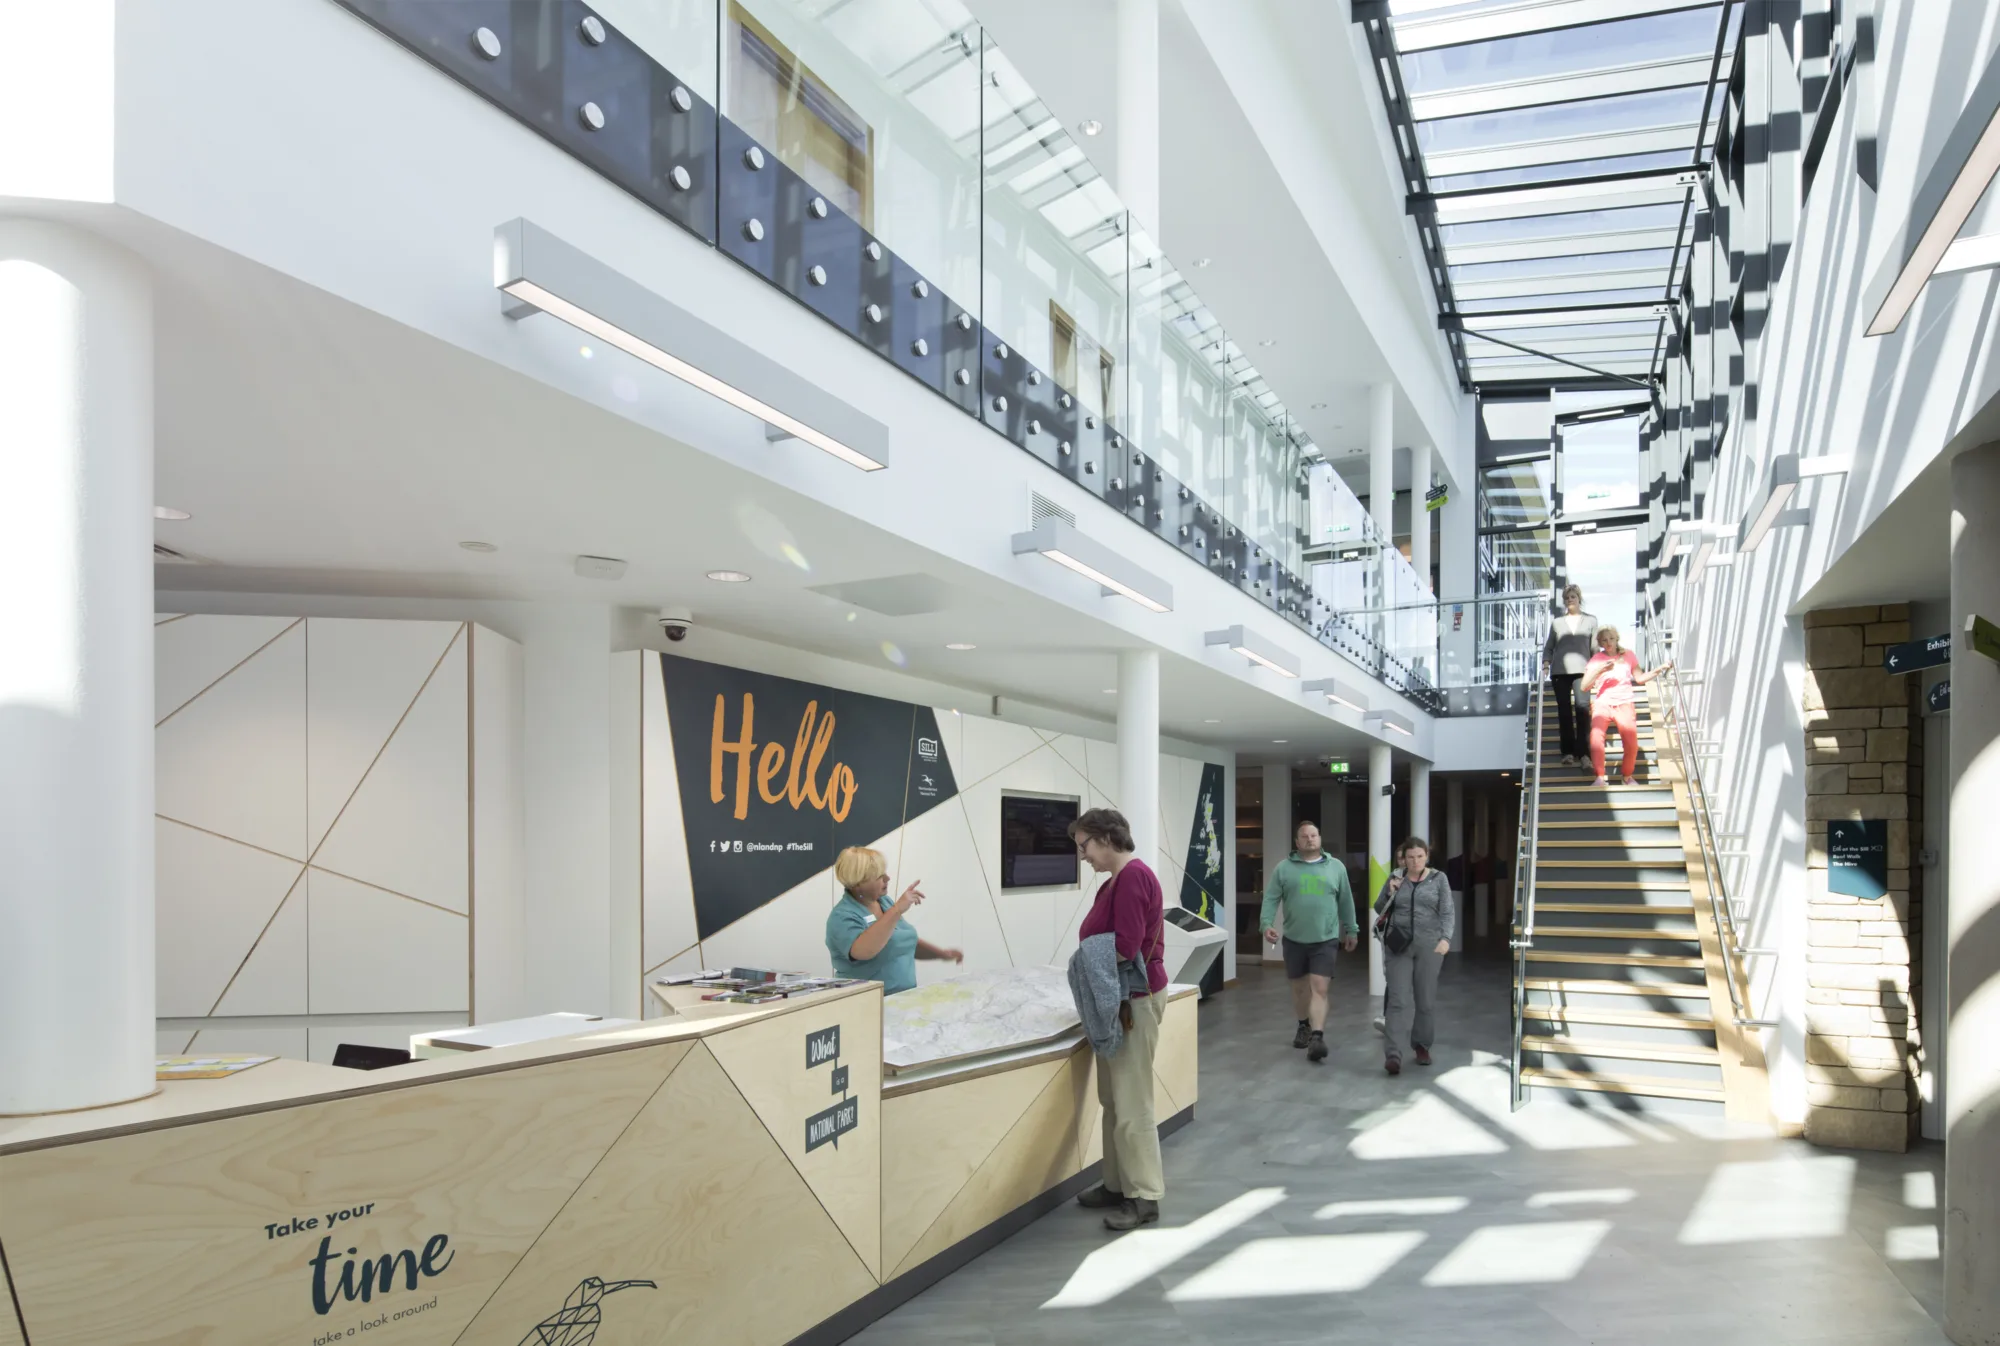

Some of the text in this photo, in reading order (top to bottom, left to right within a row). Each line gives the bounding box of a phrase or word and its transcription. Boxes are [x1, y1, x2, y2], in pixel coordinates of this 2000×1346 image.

[710, 692, 858, 823] Hello
[921, 742, 934, 752] SILL
[746, 842, 813, 852] @nlandnp #TheSill
[812, 1031, 836, 1062] What
[836, 1077, 840, 1086] is
[810, 1106, 854, 1144] NATIONAL PARK?
[264, 1203, 375, 1240] Take your
[309, 1234, 456, 1315] time
[313, 1296, 438, 1346] take a look around
